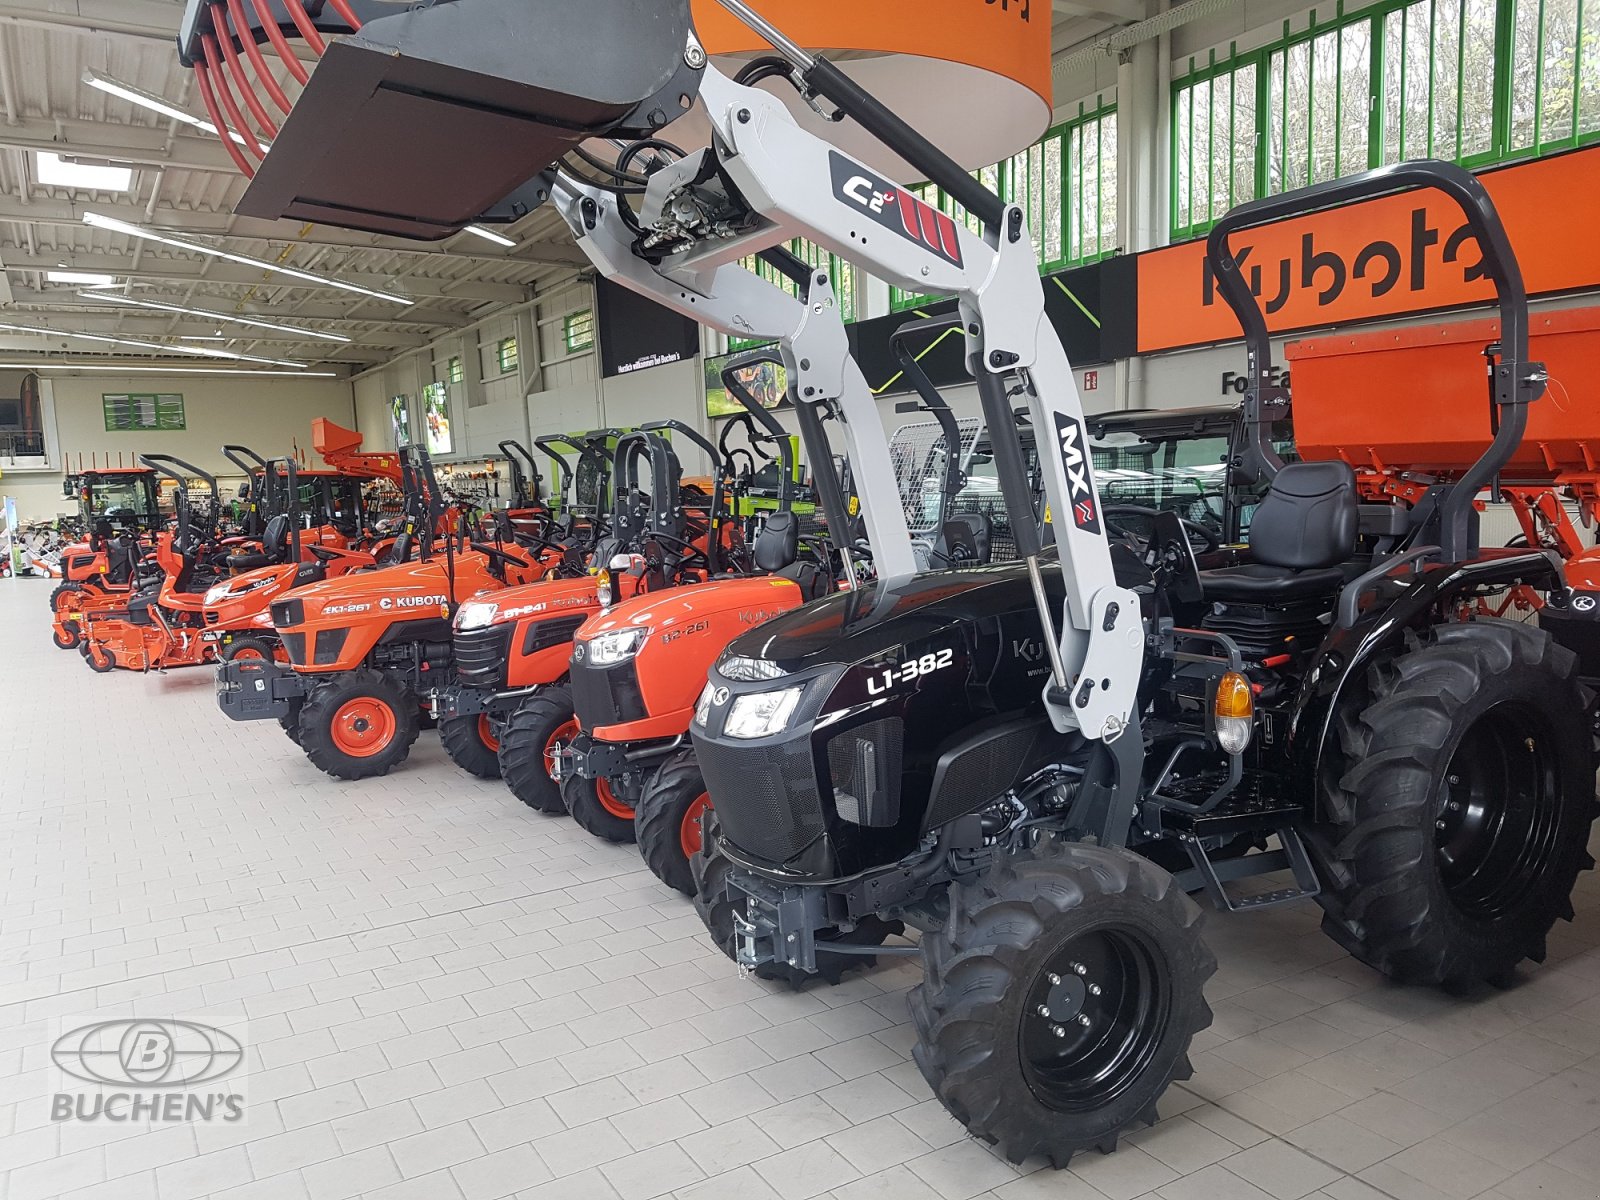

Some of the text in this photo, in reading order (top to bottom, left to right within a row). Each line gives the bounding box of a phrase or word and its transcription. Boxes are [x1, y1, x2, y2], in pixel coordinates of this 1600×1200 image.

[1202, 208, 1493, 314] Kubota
[1060, 423, 1090, 500] MX
[396, 595, 448, 608] KUBOTA
[866, 648, 953, 695] L1-382
